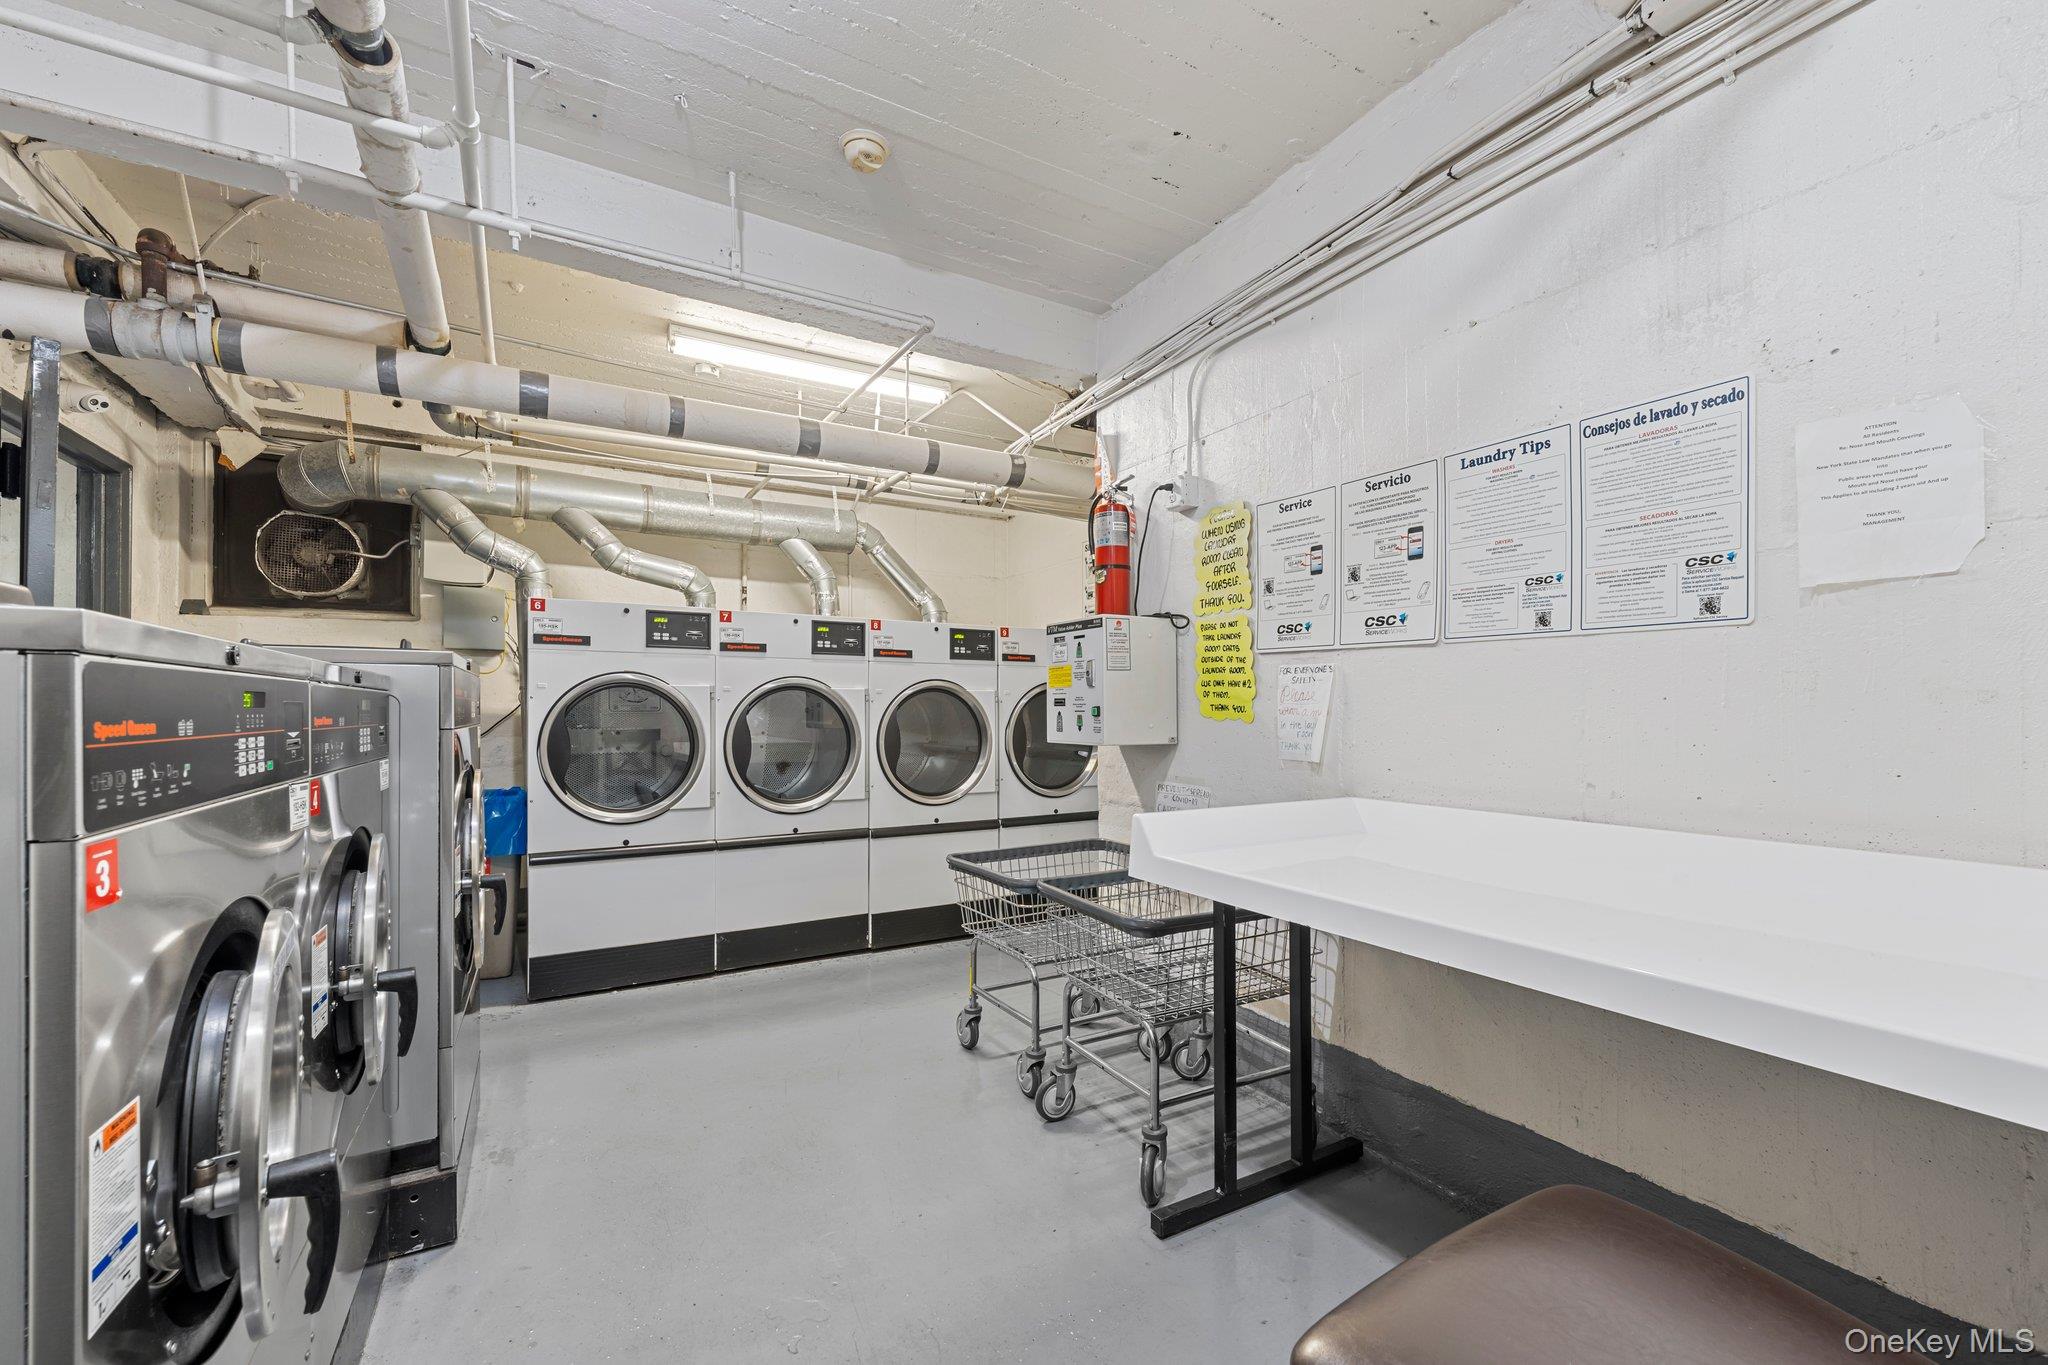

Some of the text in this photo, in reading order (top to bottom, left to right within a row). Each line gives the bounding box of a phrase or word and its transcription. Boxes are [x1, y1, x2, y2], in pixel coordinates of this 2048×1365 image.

[1583, 387, 1745, 439] Consejos de lavado y secado
[1638, 425, 1678, 439] LAVADORAS
[1864, 421, 1897, 430] ATTENTION
[1460, 439, 1551, 470] Laundry Tips
[1365, 473, 1411, 493] Servicio
[1278, 499, 1313, 514] Service
[1639, 510, 1678, 522] SECADORAS
[1202, 518, 1245, 539] WHEN USING
[1685, 554, 1725, 568] CSC
[1213, 562, 1237, 576] AFTER
[1525, 576, 1554, 586] CSC
[1200, 597, 1224, 609] THANK
[1228, 620, 1238, 628] NOT
[1364, 614, 1397, 628] CSC
[1277, 623, 1303, 634] CSC
[1217, 632, 1241, 640] LAUNDRY
[1280, 667, 1291, 675] FOR
[1228, 680, 1241, 688] HAVE
[1210, 704, 1230, 712] THANK
[93, 719, 157, 742] Speed Queen
[313, 790, 318, 810] 4
[96, 860, 111, 898] 3
